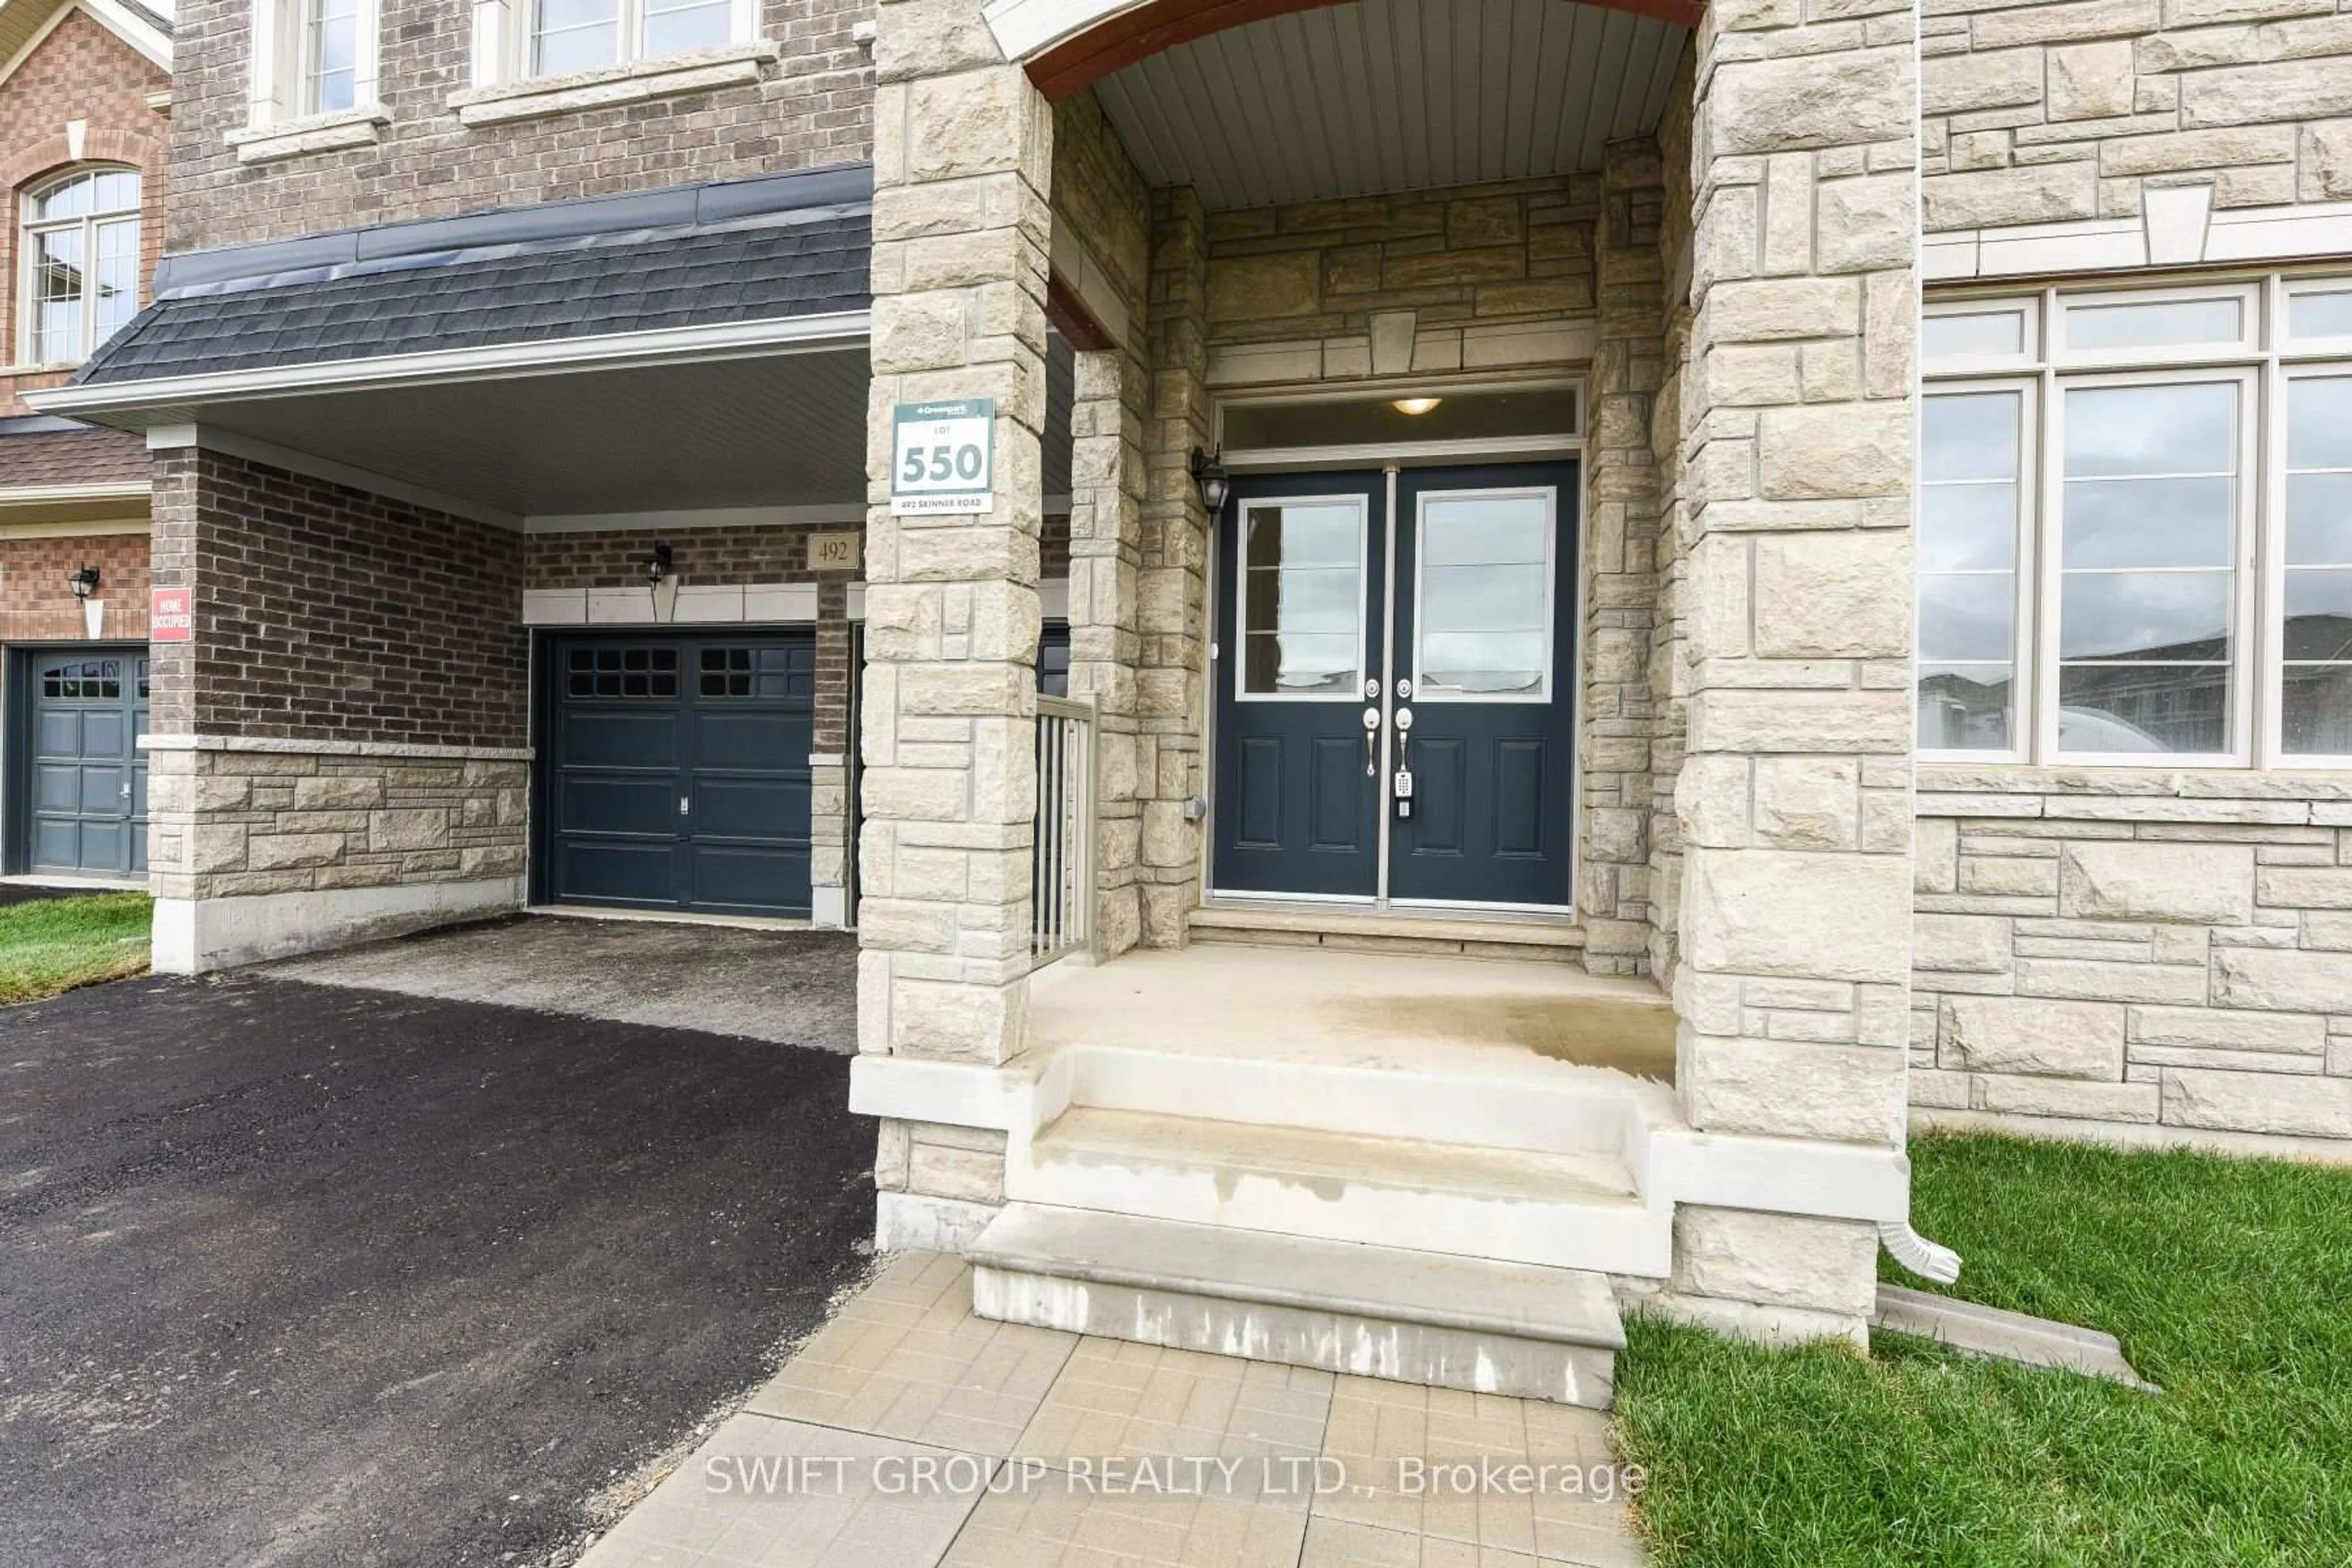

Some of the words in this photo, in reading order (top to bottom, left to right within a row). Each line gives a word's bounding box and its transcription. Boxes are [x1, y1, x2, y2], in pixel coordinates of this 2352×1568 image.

[902, 443, 982, 483] 550
[957, 498, 981, 507] ROAD
[818, 541, 848, 562] 492
[159, 598, 182, 613] HOME
[153, 614, 190, 628] OCCUPIED
